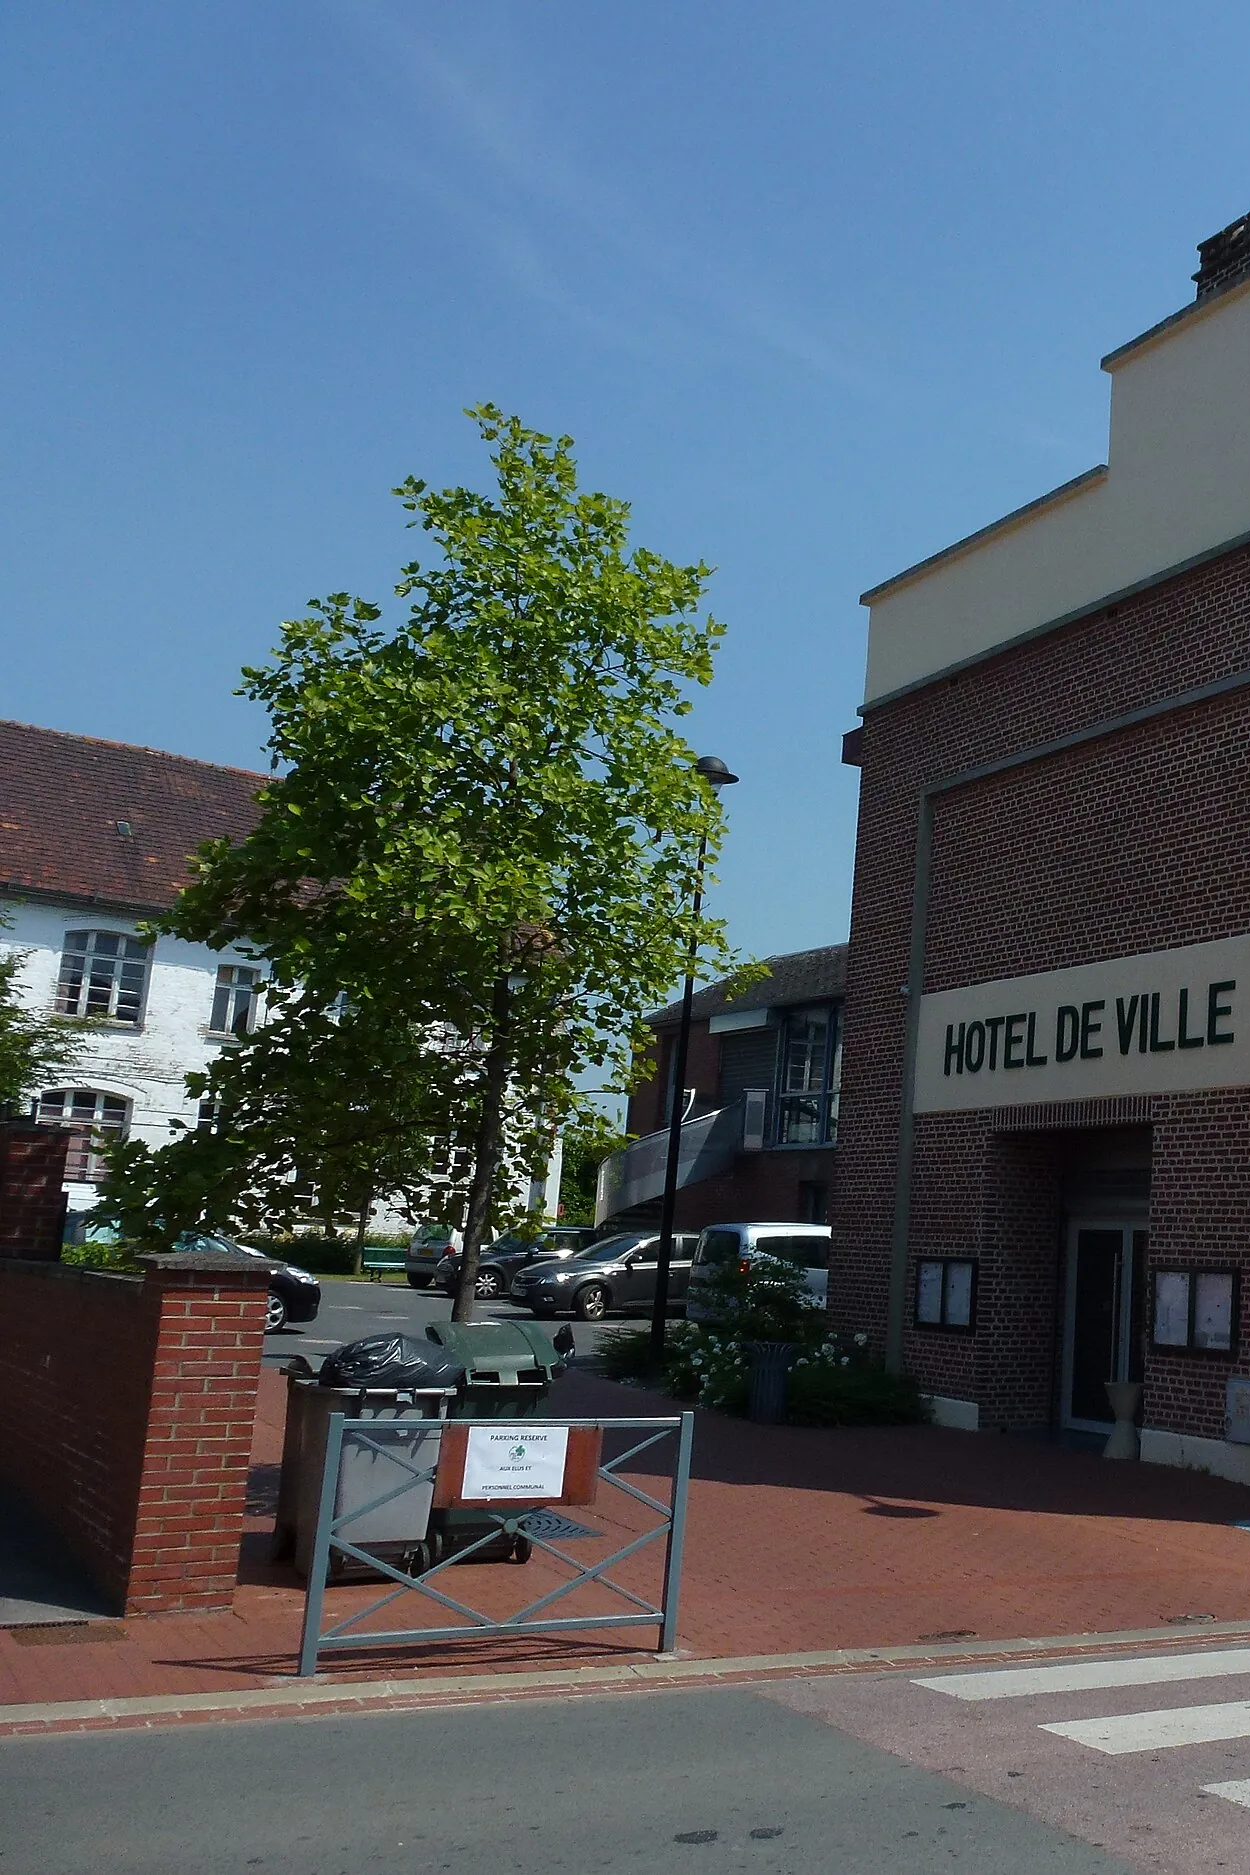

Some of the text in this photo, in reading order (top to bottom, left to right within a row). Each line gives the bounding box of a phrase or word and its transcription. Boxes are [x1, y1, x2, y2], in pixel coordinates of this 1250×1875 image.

[943, 980, 1236, 1076] HOTEL DE VILLE
